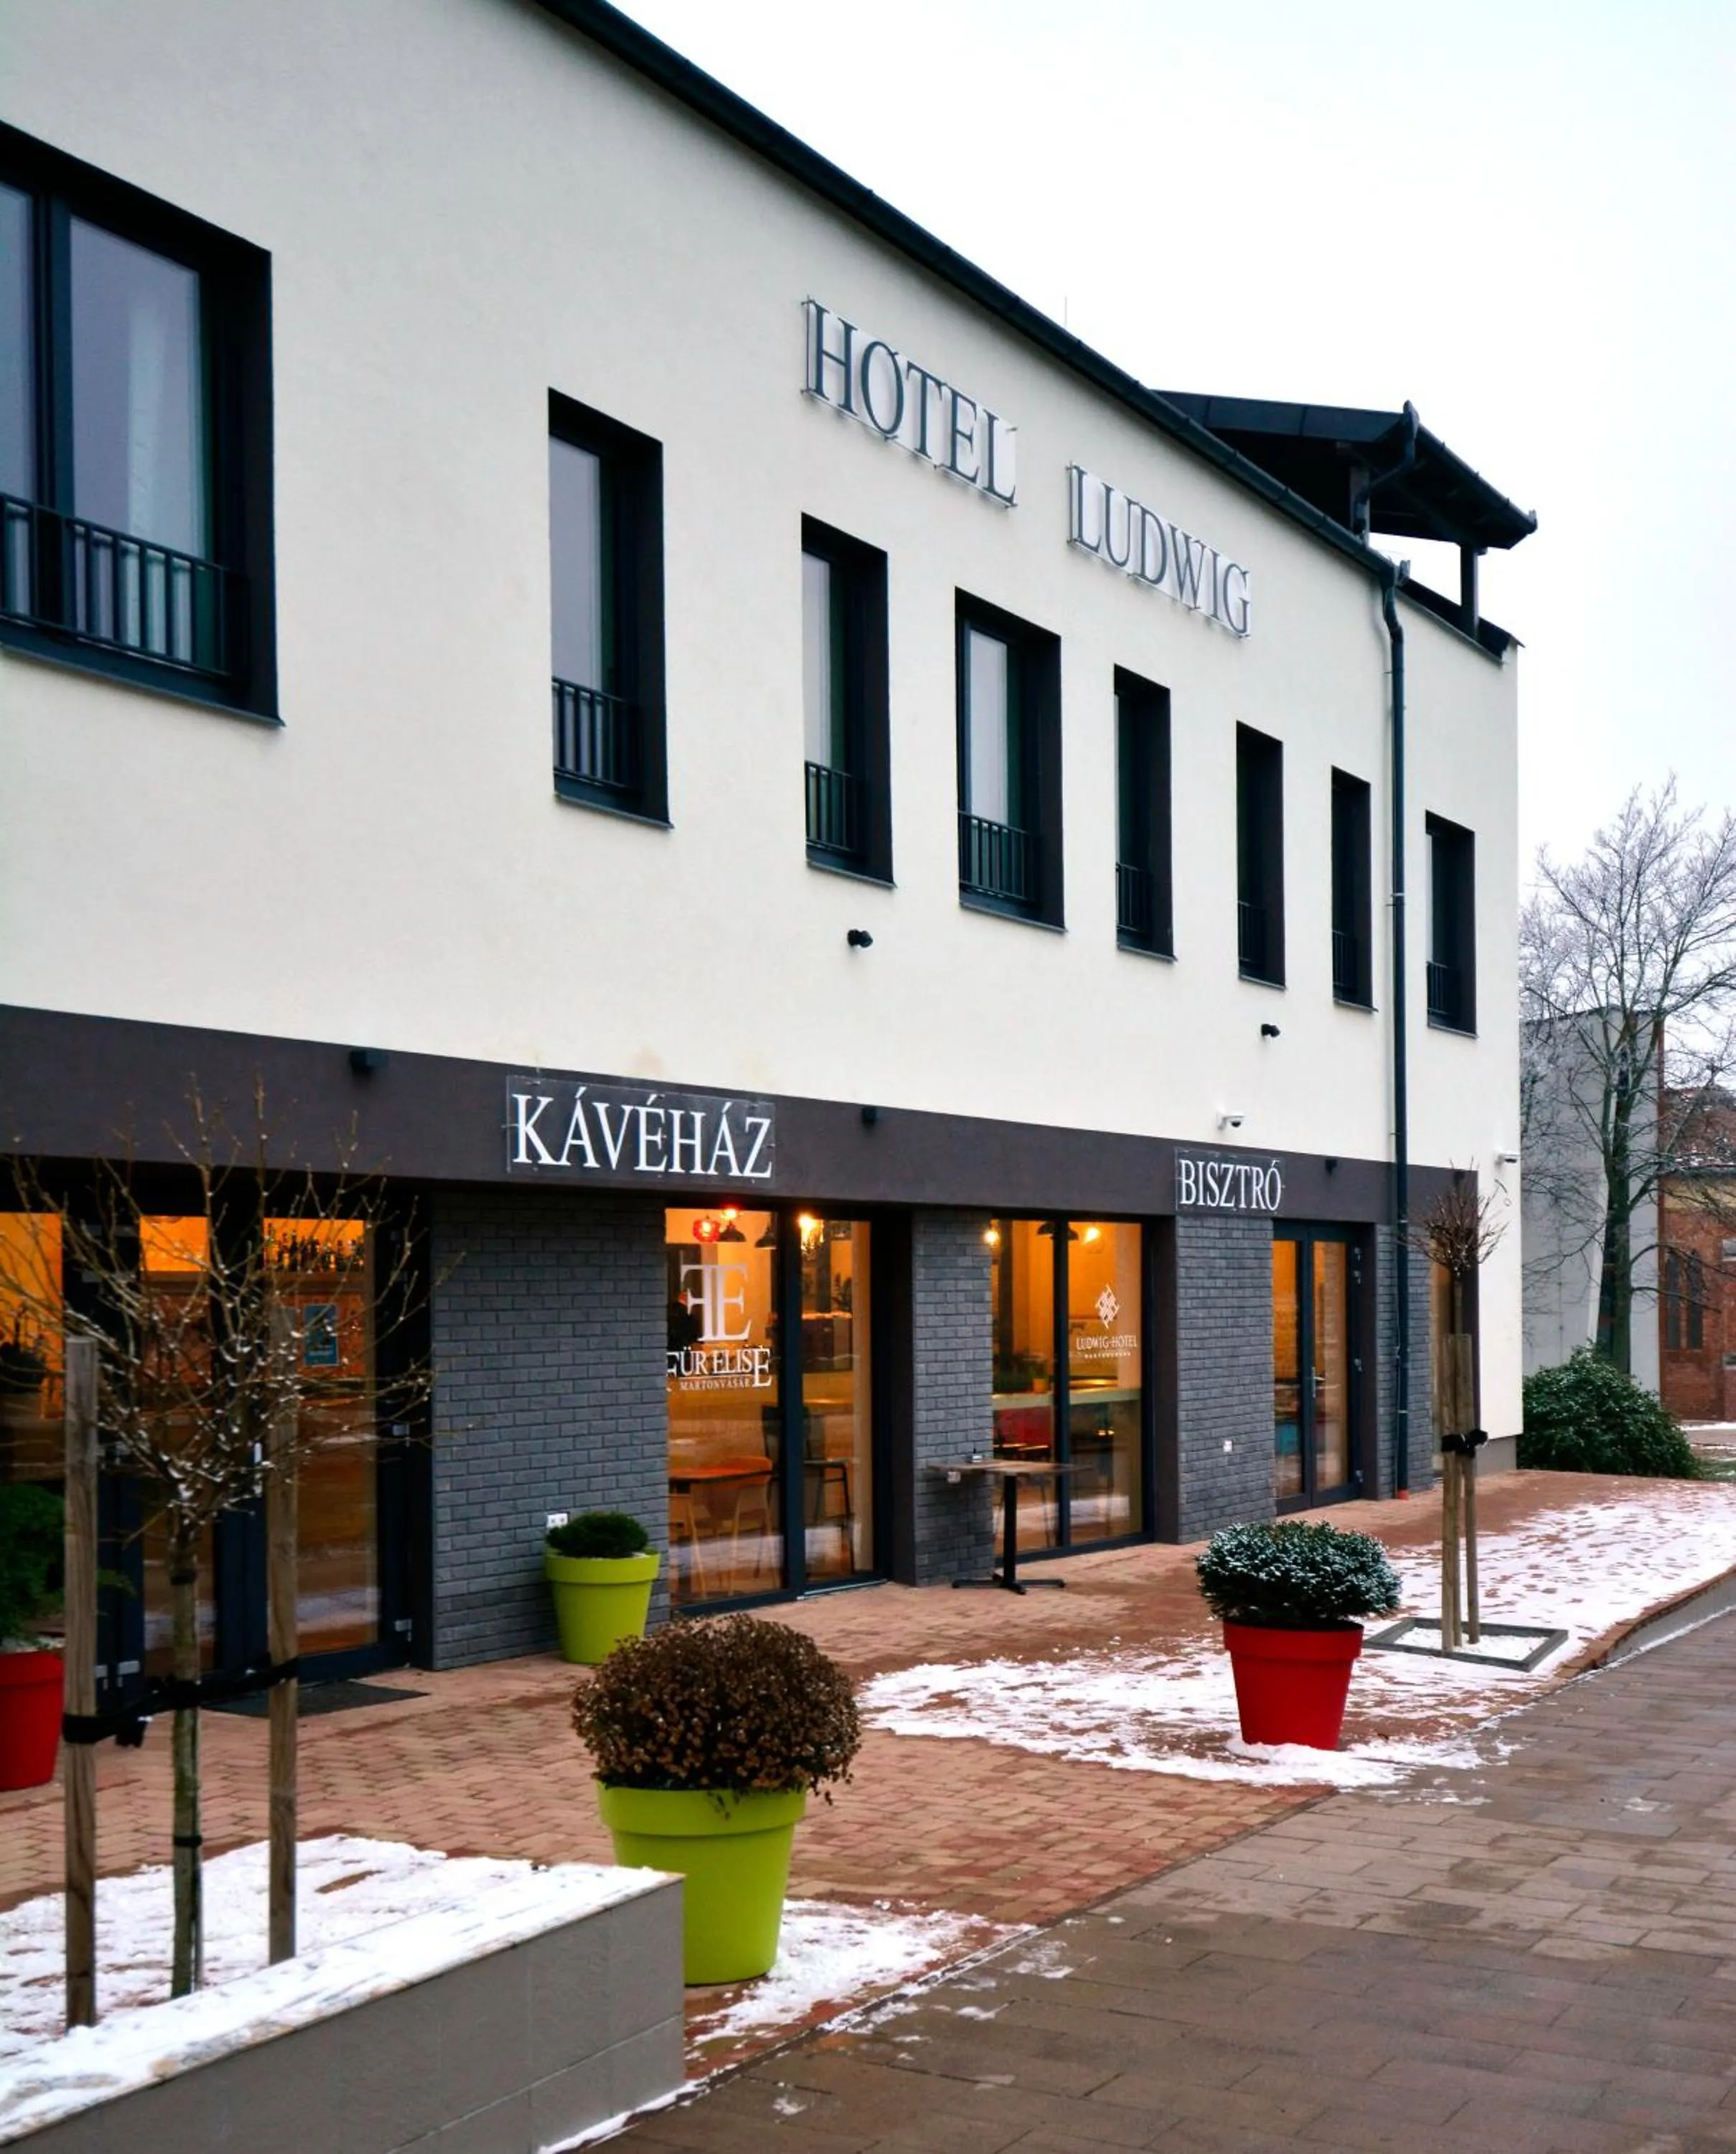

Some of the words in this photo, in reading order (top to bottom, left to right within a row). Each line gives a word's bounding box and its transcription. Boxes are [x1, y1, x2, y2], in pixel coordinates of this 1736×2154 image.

[810, 299, 1016, 505] HOTEL
[1073, 465, 1249, 637] LUDWIG
[512, 1086, 773, 1178] KÁVÉHÁZ
[1180, 1160, 1282, 1211] BISZTRÓ
[712, 1347, 772, 1387] ELISE
